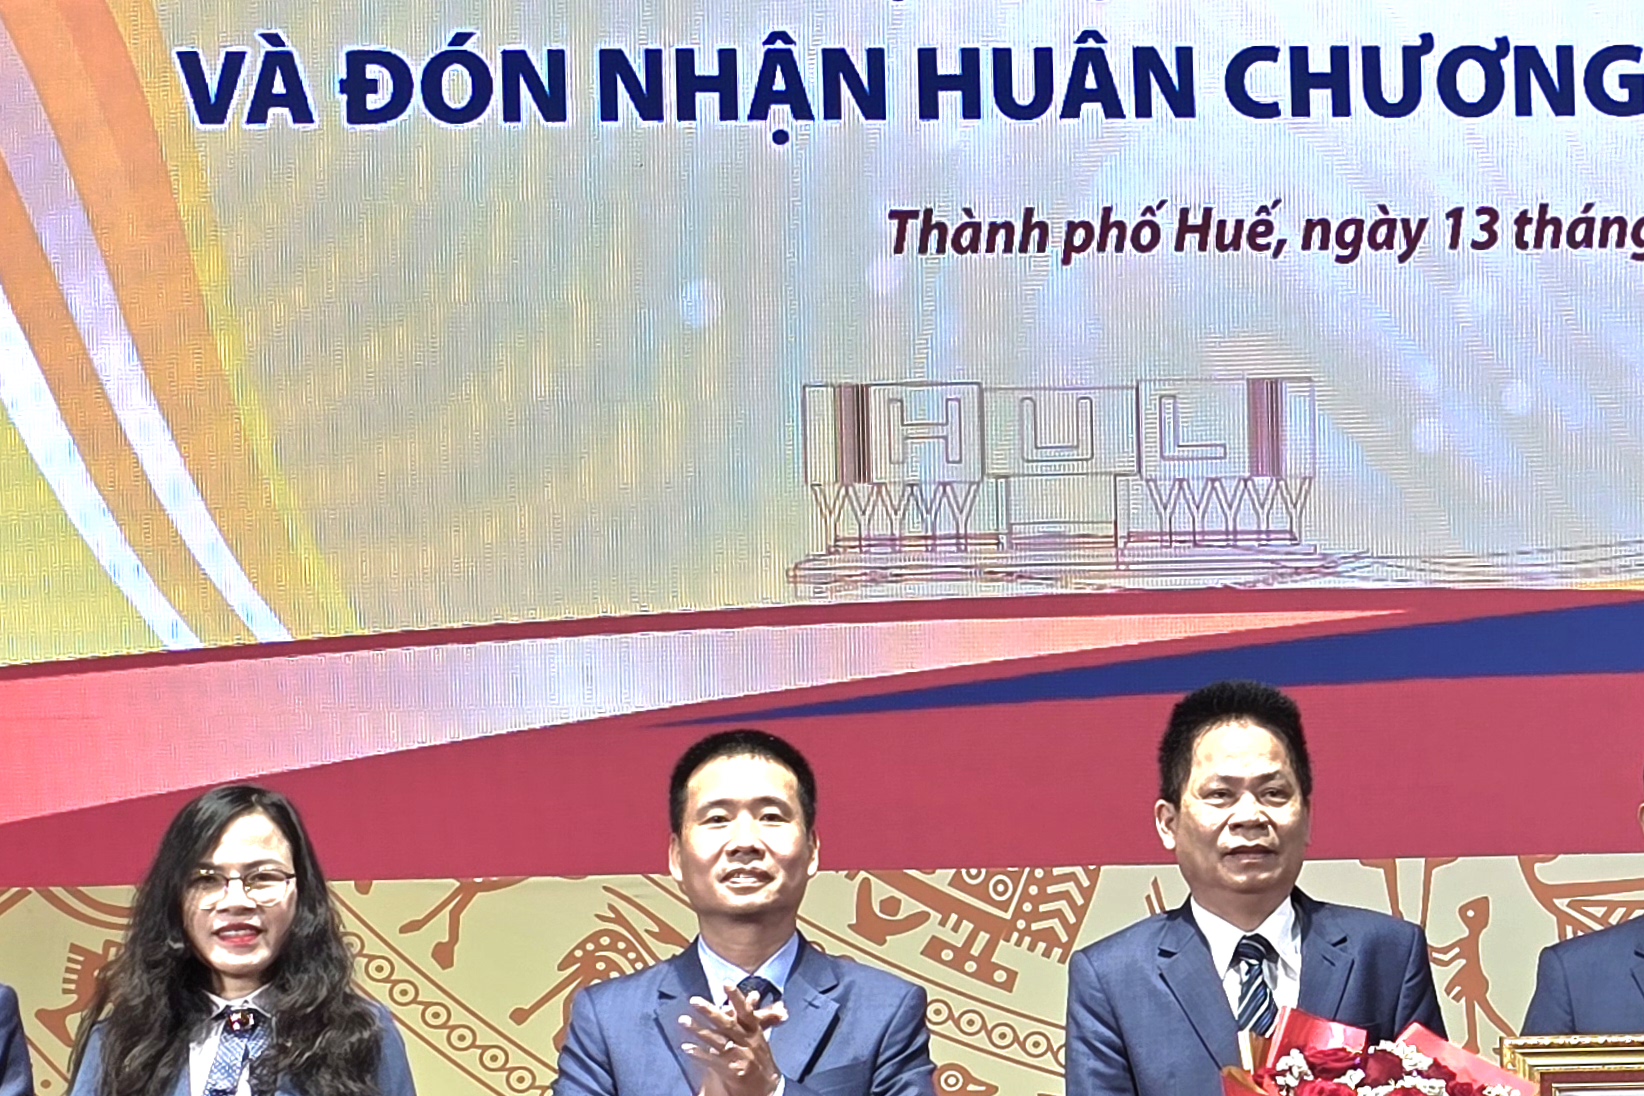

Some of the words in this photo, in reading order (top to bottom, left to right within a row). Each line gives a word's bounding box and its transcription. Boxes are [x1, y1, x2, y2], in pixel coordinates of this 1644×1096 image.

[177, 32, 313, 125] VÀ
[340, 31, 566, 125] ĐÓN
[599, 30, 886, 145] NHẬN
[918, 29, 1195, 121] HUÂN
[888, 206, 1048, 255] Thành
[1061, 199, 1168, 266] phố
[1174, 199, 1287, 260] Huế,
[1301, 204, 1428, 265] ngày
[1445, 206, 1499, 251] 13
